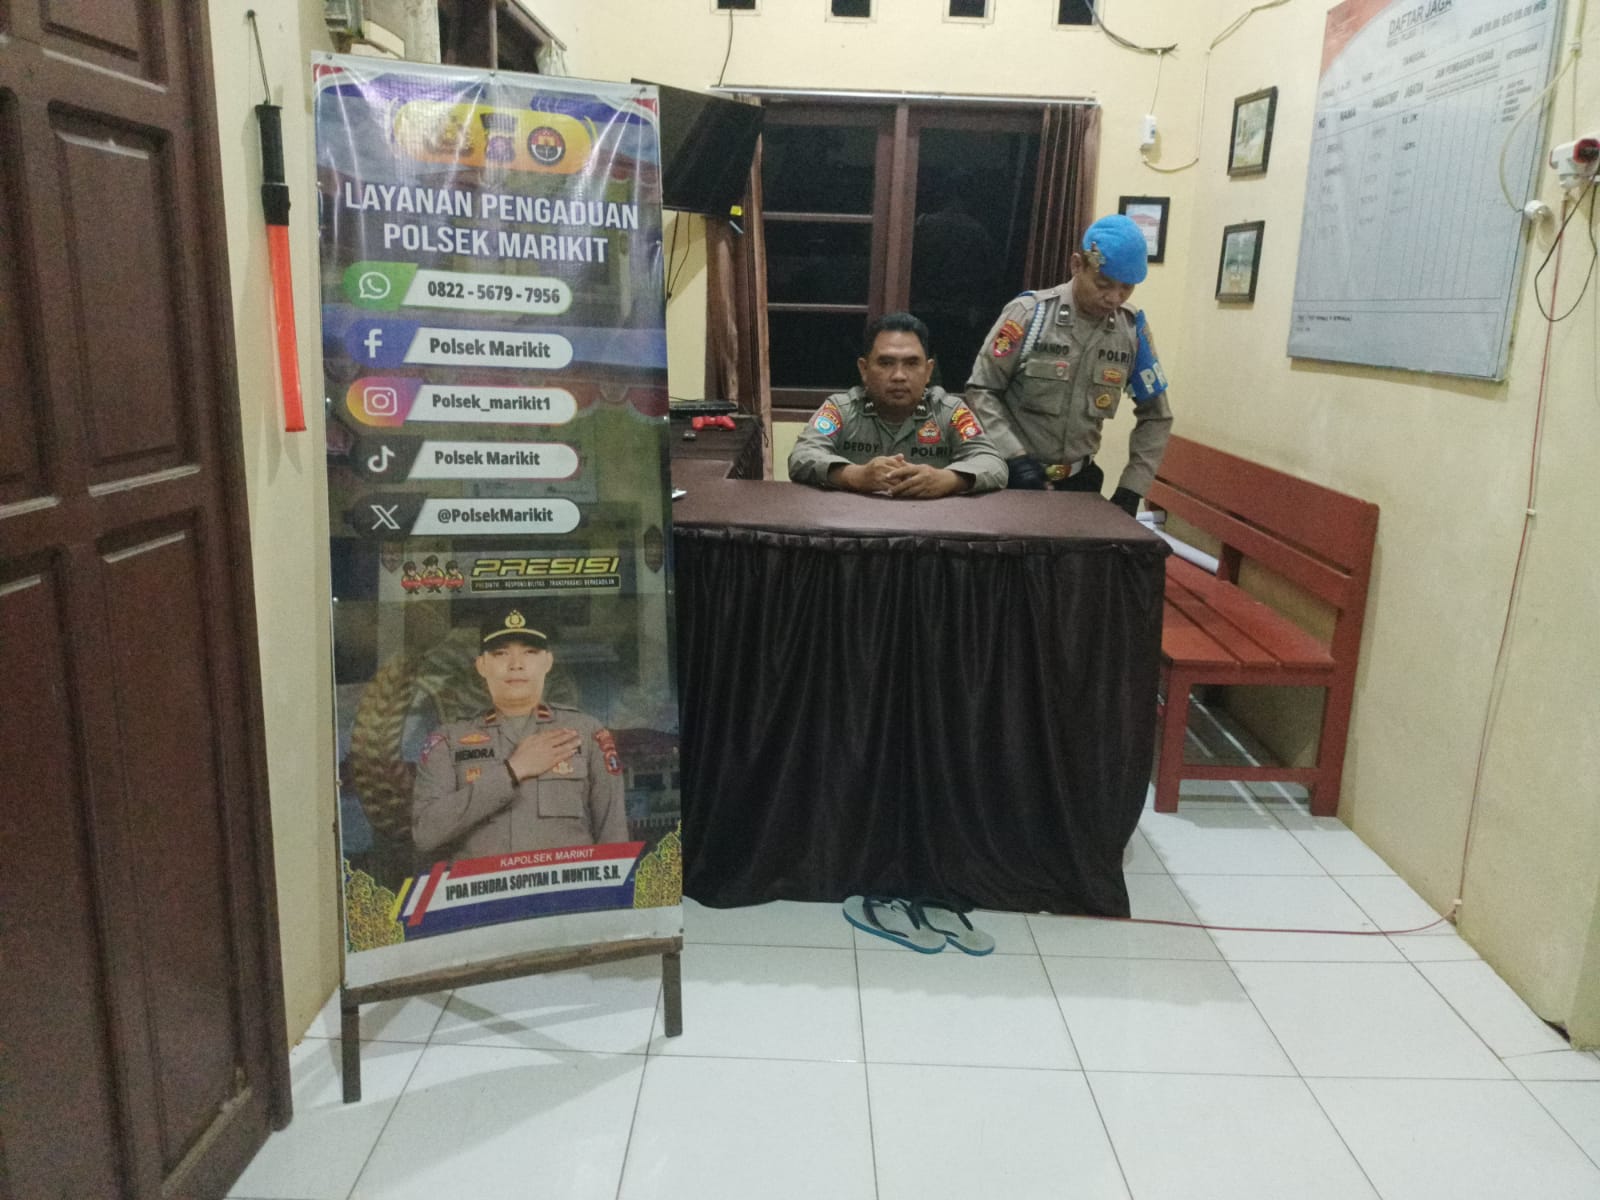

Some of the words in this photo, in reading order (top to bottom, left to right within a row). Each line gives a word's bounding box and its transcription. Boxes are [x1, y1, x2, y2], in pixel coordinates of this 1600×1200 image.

[1389, 6, 1424, 35] DAFTAR
[345, 182, 473, 218] LAYANAN
[482, 195, 639, 230] PENGADUAN
[384, 224, 490, 256] POLSEK
[499, 232, 609, 263] MARIKIT
[428, 281, 464, 298] 0822
[477, 284, 513, 301] 5679
[525, 287, 560, 303] 7956
[429, 337, 485, 356] Polsek
[489, 340, 551, 358] Marikit
[1098, 348, 1132, 364] POLRI
[432, 394, 551, 412] Polsek_marikit1
[844, 441, 880, 453] DEDDY
[911, 446, 953, 457] POLRI
[434, 451, 483, 465] Polsek
[486, 451, 540, 466] Marikit
[437, 508, 553, 524] @PolsekMarikit
[472, 557, 620, 576] PRESISI
[455, 748, 495, 762] HENDRA
[500, 852, 552, 867] KAPOLSEK
[555, 848, 594, 860] MARIKIT
[446, 884, 469, 900] IPDA
[470, 877, 508, 896] HENDRA
[510, 872, 549, 891] SOPIYAN
[603, 865, 621, 880] S.H.
